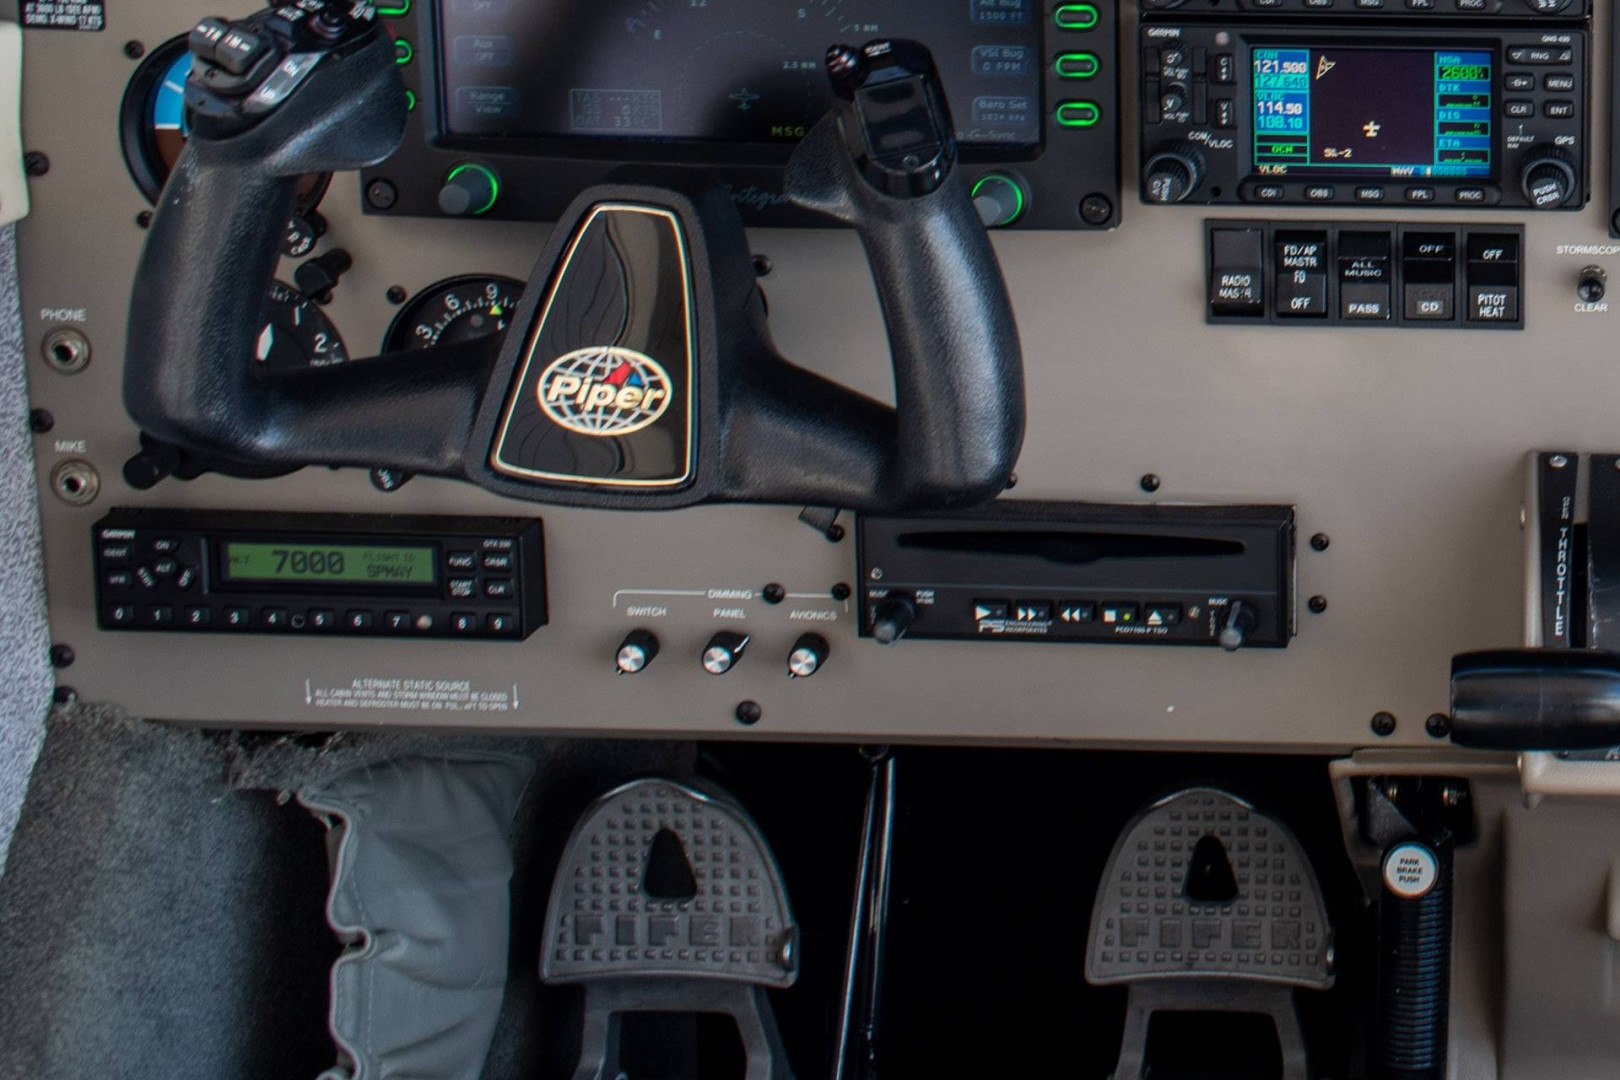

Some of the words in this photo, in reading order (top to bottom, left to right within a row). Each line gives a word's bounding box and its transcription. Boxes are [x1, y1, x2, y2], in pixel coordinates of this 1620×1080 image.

[1548, 79, 1572, 88] MENU
[1550, 107, 1568, 115] ENT
[1533, 184, 1557, 196] PUSH
[1284, 245, 1317, 255] FD/AP
[1419, 244, 1443, 254] OFF
[1483, 249, 1503, 261] OFF
[1283, 256, 1317, 268] MASTR
[1221, 275, 1250, 287] RADIO
[1291, 297, 1311, 310] OFF
[1478, 294, 1506, 306] PITOT
[1348, 304, 1380, 314] PASS
[1421, 301, 1438, 313] CD
[1479, 306, 1505, 318] HEAT
[1574, 303, 1608, 313] CLEAR
[41, 309, 87, 321] PHONE
[547, 376, 665, 411] Piper
[55, 441, 87, 452] MIKE
[271, 550, 345, 573] 7000
[1554, 528, 1568, 636] THROTTLE
[627, 607, 667, 617] SWITCH
[713, 609, 747, 618] PANEL
[789, 611, 837, 620] AVIONICS
